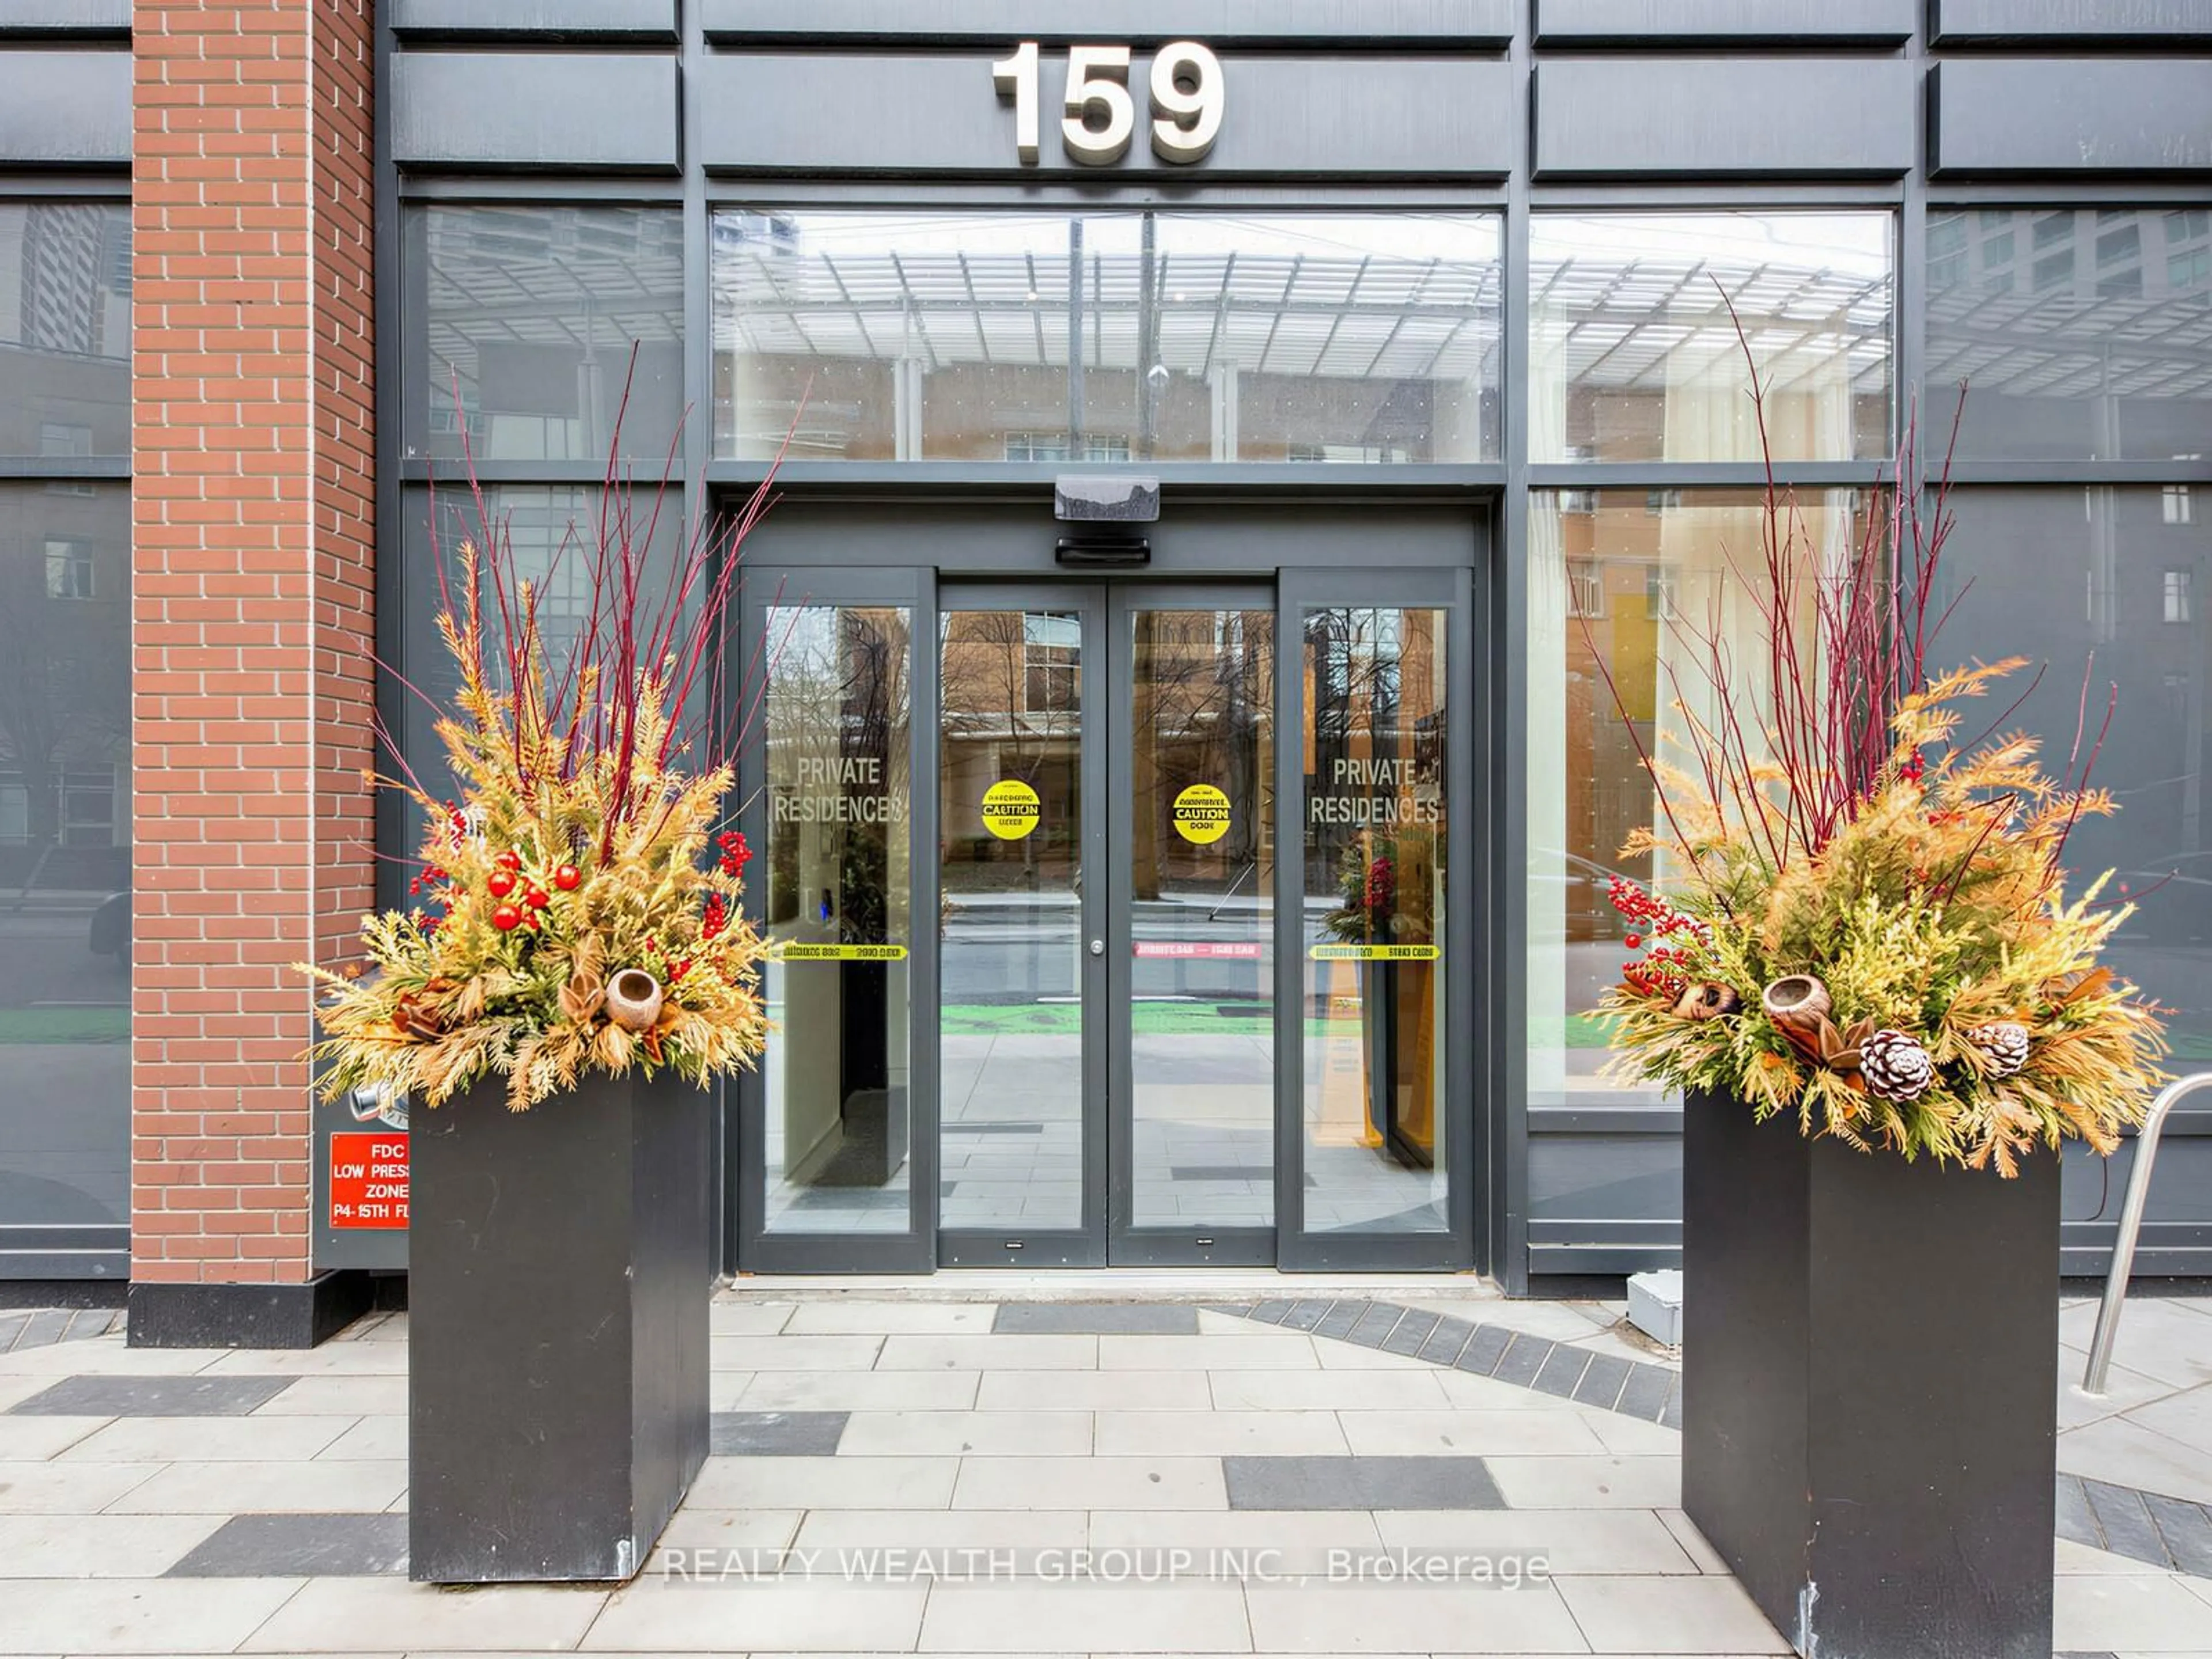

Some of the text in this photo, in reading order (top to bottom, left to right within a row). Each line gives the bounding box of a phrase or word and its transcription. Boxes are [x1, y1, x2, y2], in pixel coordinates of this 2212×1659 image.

[992, 41, 1224, 165] 159
[797, 757, 880, 784] PRIVATE
[1334, 758, 1416, 785] PRIVATE
[775, 796, 902, 822] RESIDENCES
[983, 805, 1038, 815] CAUTION
[1176, 808, 1229, 819] CAUTION
[1311, 797, 1438, 823] RESIDENCES
[371, 1144, 405, 1158] FDC
[334, 1164, 365, 1179] LOW
[365, 1184, 409, 1198] ZONE
